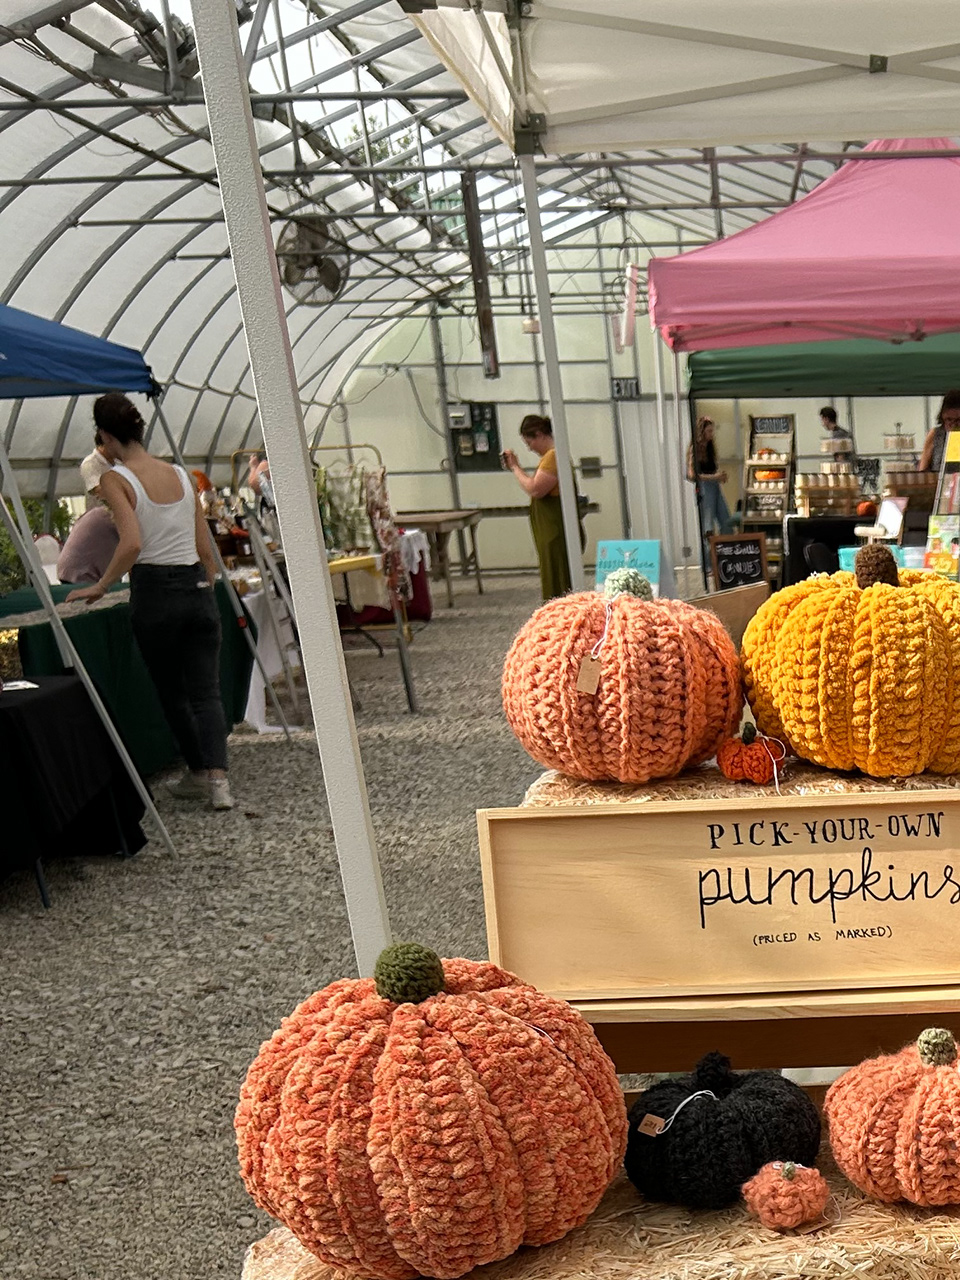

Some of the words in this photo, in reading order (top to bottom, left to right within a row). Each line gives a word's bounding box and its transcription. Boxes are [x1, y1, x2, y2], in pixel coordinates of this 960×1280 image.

[612, 379, 637, 398] EXIT
[707, 811, 945, 850] PICK-YOUR-OWN
[752, 931, 798, 946] (PRICED
[807, 932, 822, 942] AS
[835, 925, 893, 941] MARKED)
